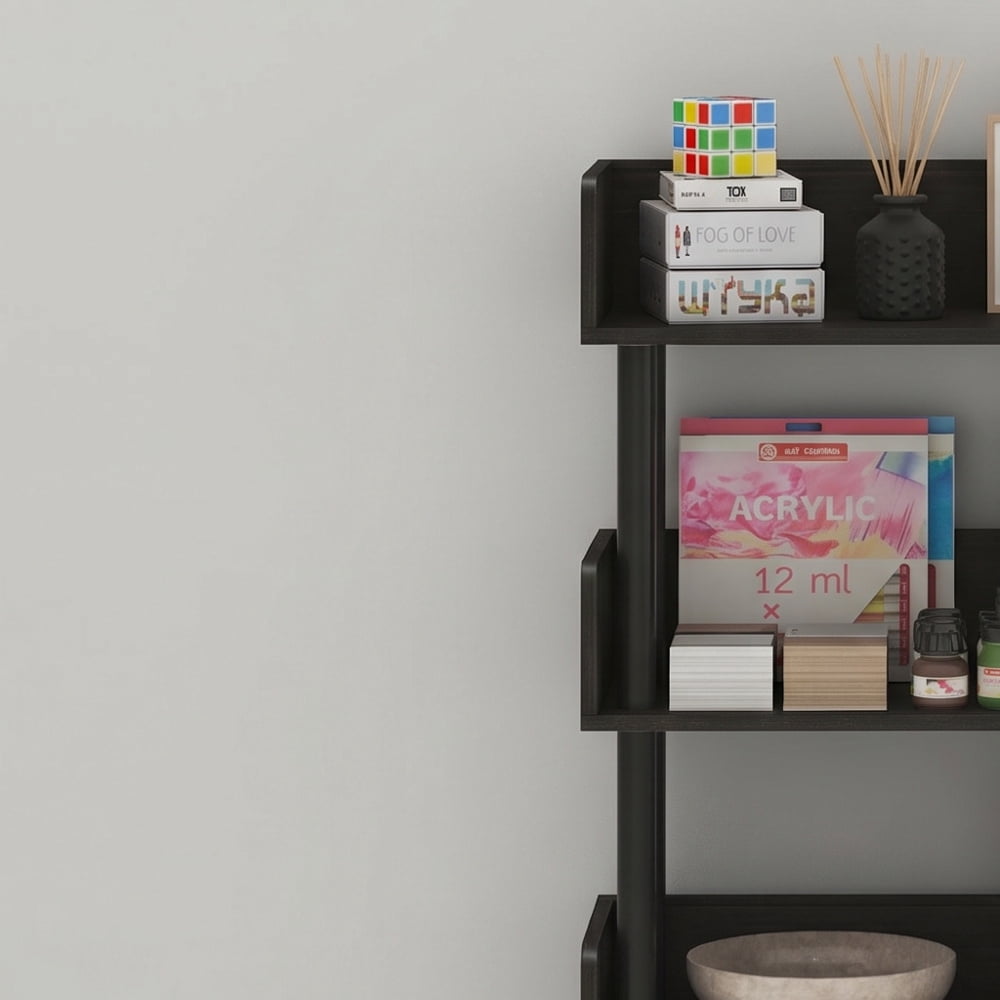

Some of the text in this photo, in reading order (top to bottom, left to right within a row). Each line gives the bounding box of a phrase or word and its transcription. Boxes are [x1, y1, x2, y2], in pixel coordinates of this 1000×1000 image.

[726, 185, 747, 197] TOX
[696, 226, 797, 243] FOG OF LOVE
[728, 495, 877, 521] ACRYLIC
[755, 563, 852, 594] 12 ml
